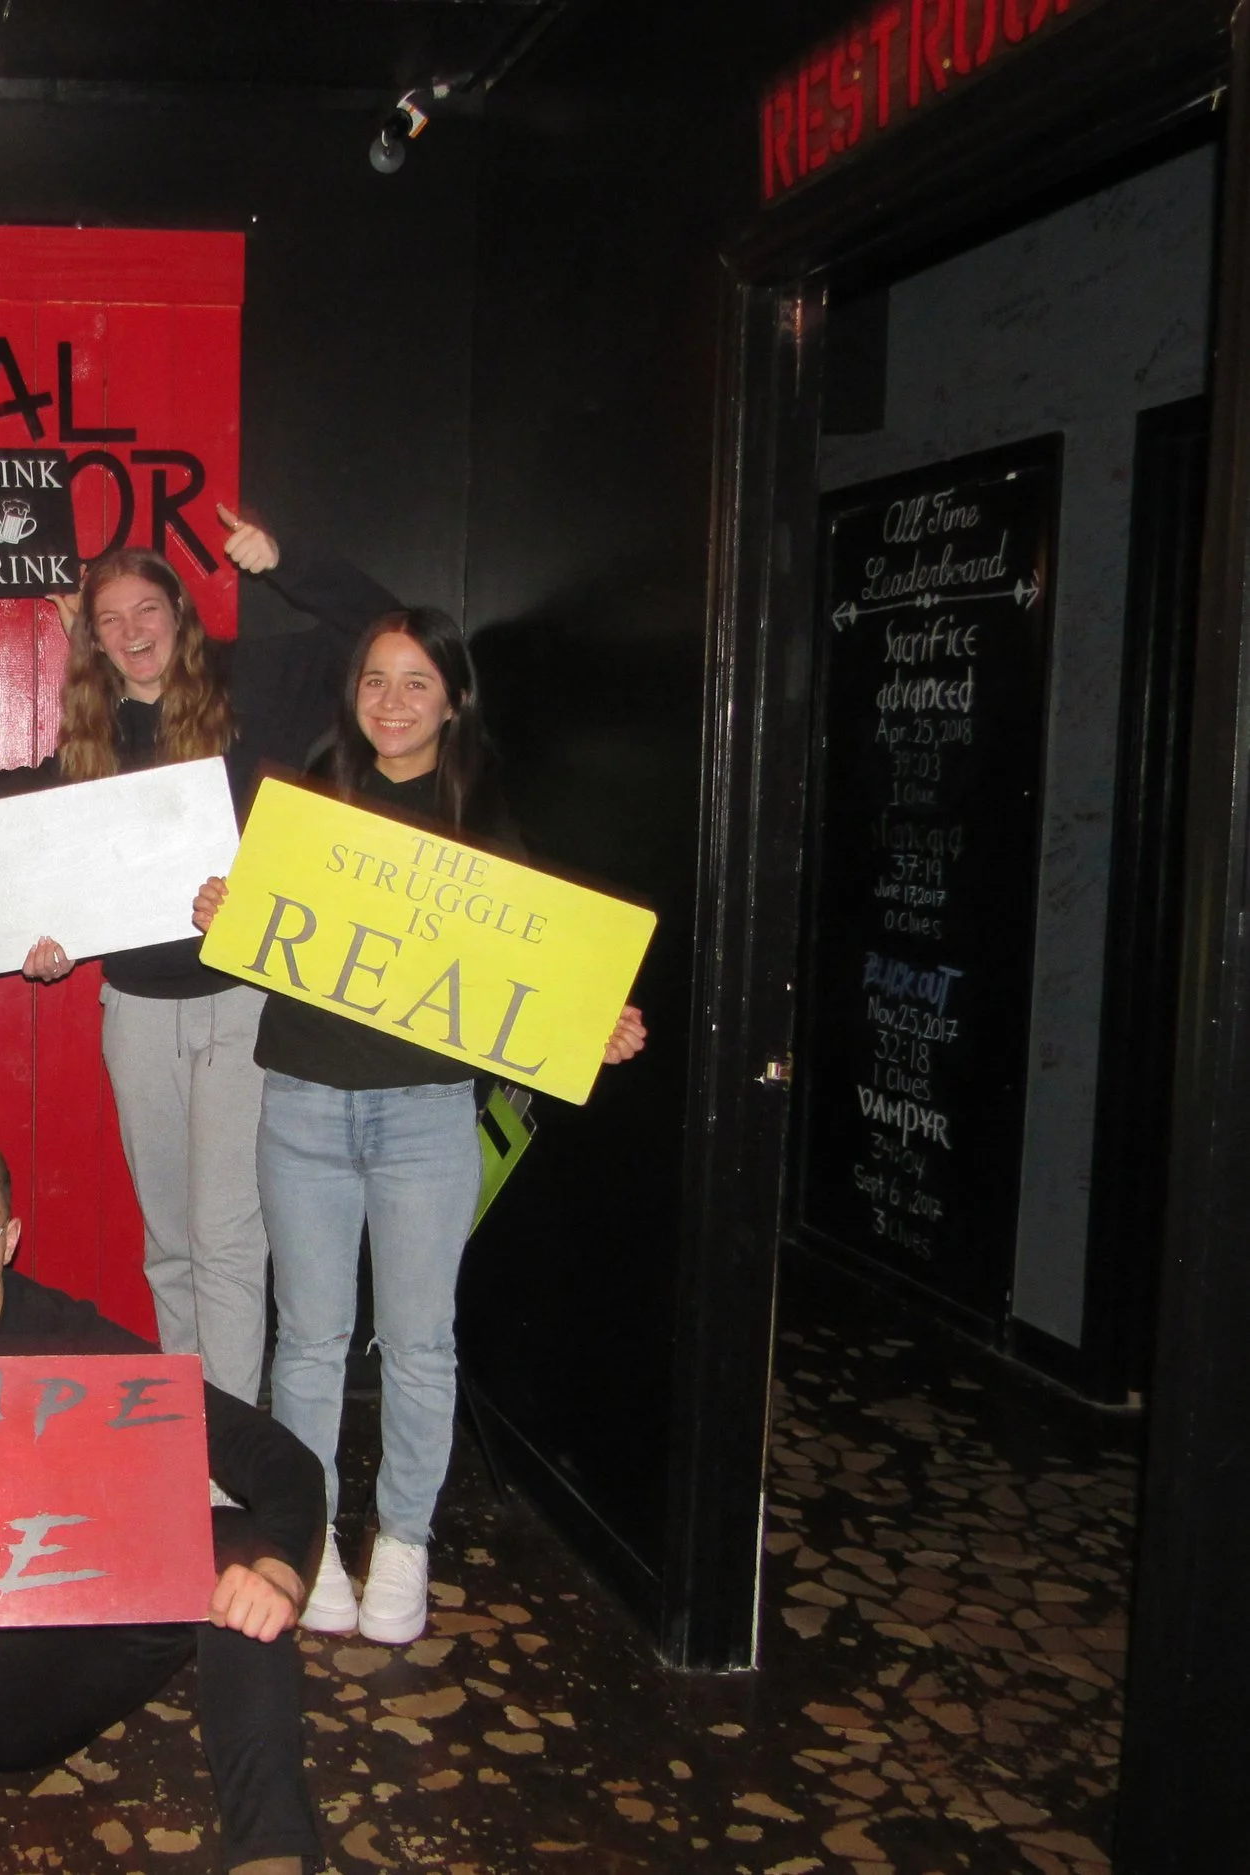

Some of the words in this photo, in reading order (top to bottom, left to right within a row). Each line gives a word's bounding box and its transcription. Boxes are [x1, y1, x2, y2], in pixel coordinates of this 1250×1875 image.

[762, 0, 1072, 200] RESTRO
[883, 495, 927, 544] All
[926, 487, 981, 534] Time
[861, 529, 1009, 600] Leaderboard
[409, 836, 490, 887] THE
[324, 844, 548, 944] STRUGGLE
[404, 907, 444, 942] IS
[241, 891, 548, 1077] REAL
[874, 1029, 931, 1074] 32:18
